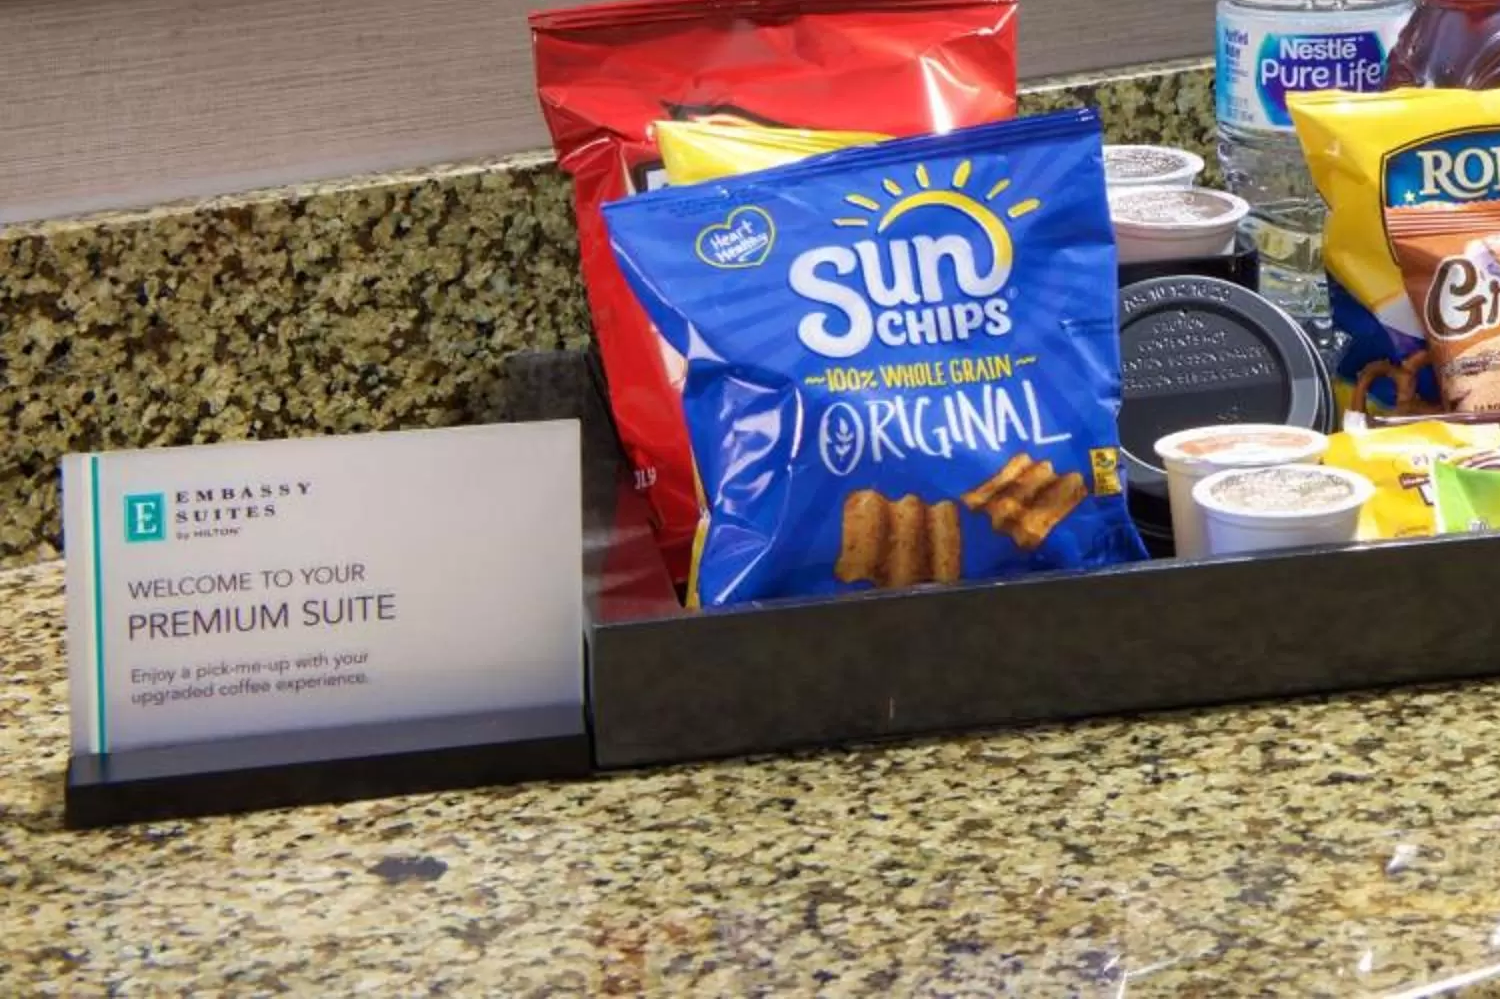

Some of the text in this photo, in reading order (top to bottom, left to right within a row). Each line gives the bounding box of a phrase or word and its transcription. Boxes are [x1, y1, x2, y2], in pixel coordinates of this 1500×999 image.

[1261, 58, 1330, 88] Pure
[1335, 59, 1381, 92] Life
[709, 219, 753, 250] Heart
[715, 232, 769, 263] Healthy
[788, 229, 1013, 358] Sun
[876, 297, 1012, 346] CHIPS
[826, 353, 1013, 392] 100% WHOLE GRAIN
[818, 379, 1073, 477] ORIGINAL
[175, 481, 312, 504] EMBASSY
[133, 501, 157, 535] E
[175, 504, 276, 524] SUITES
[128, 563, 367, 600] WELCOME TO YOUR
[128, 593, 397, 641] PREMIUM SUITE
[131, 652, 369, 687] Enjoy a pick-me-up with your
[131, 684, 215, 707] upgraded
[219, 679, 271, 697] coffee
